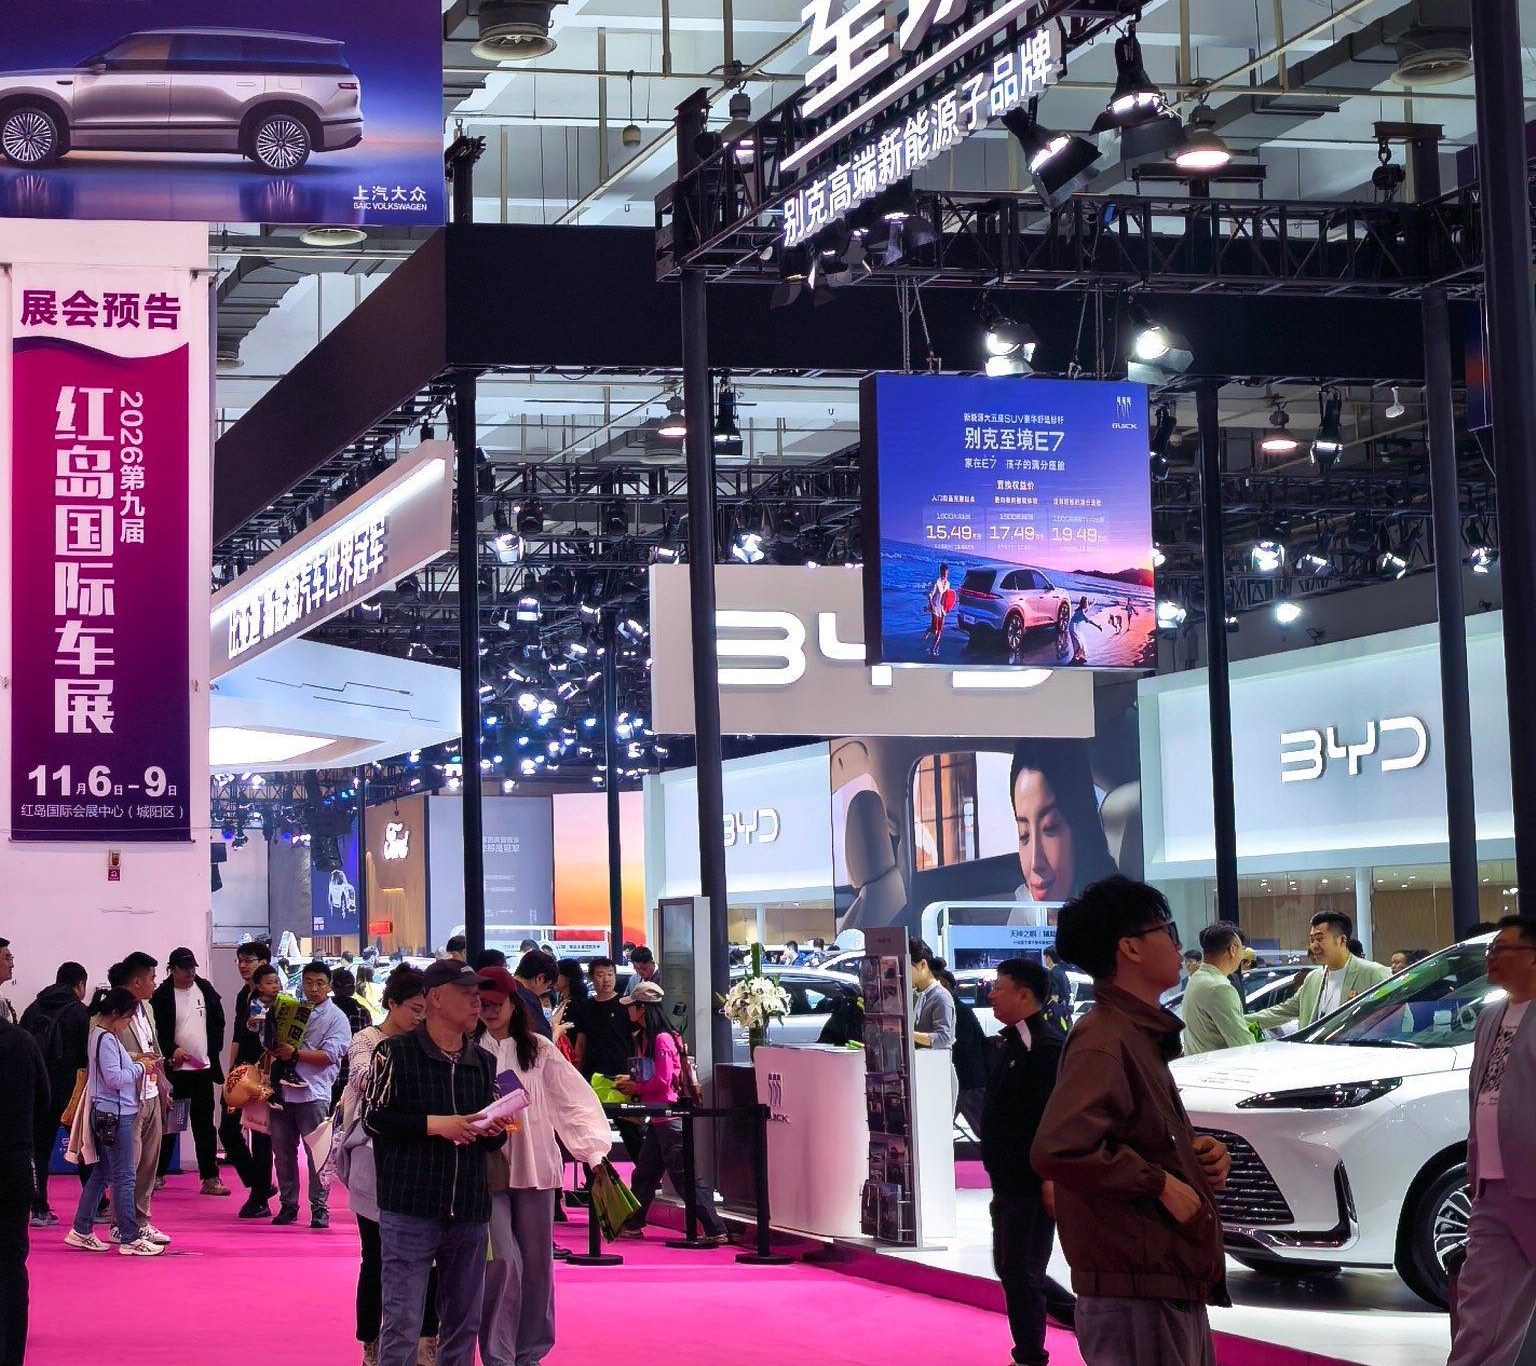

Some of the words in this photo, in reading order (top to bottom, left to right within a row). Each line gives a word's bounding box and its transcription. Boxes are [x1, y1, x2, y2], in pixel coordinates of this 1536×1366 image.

[783, 28, 1053, 246] 别克高端新能源子品牌
[353, 185, 427, 204] 上汽大众
[20, 288, 182, 330] 展会预告
[118, 390, 145, 545] 2026第九届
[964, 427, 1065, 452] 别克至境E7
[54, 385, 115, 735] 红岛国际车展
[1279, 715, 1429, 782] BYD
